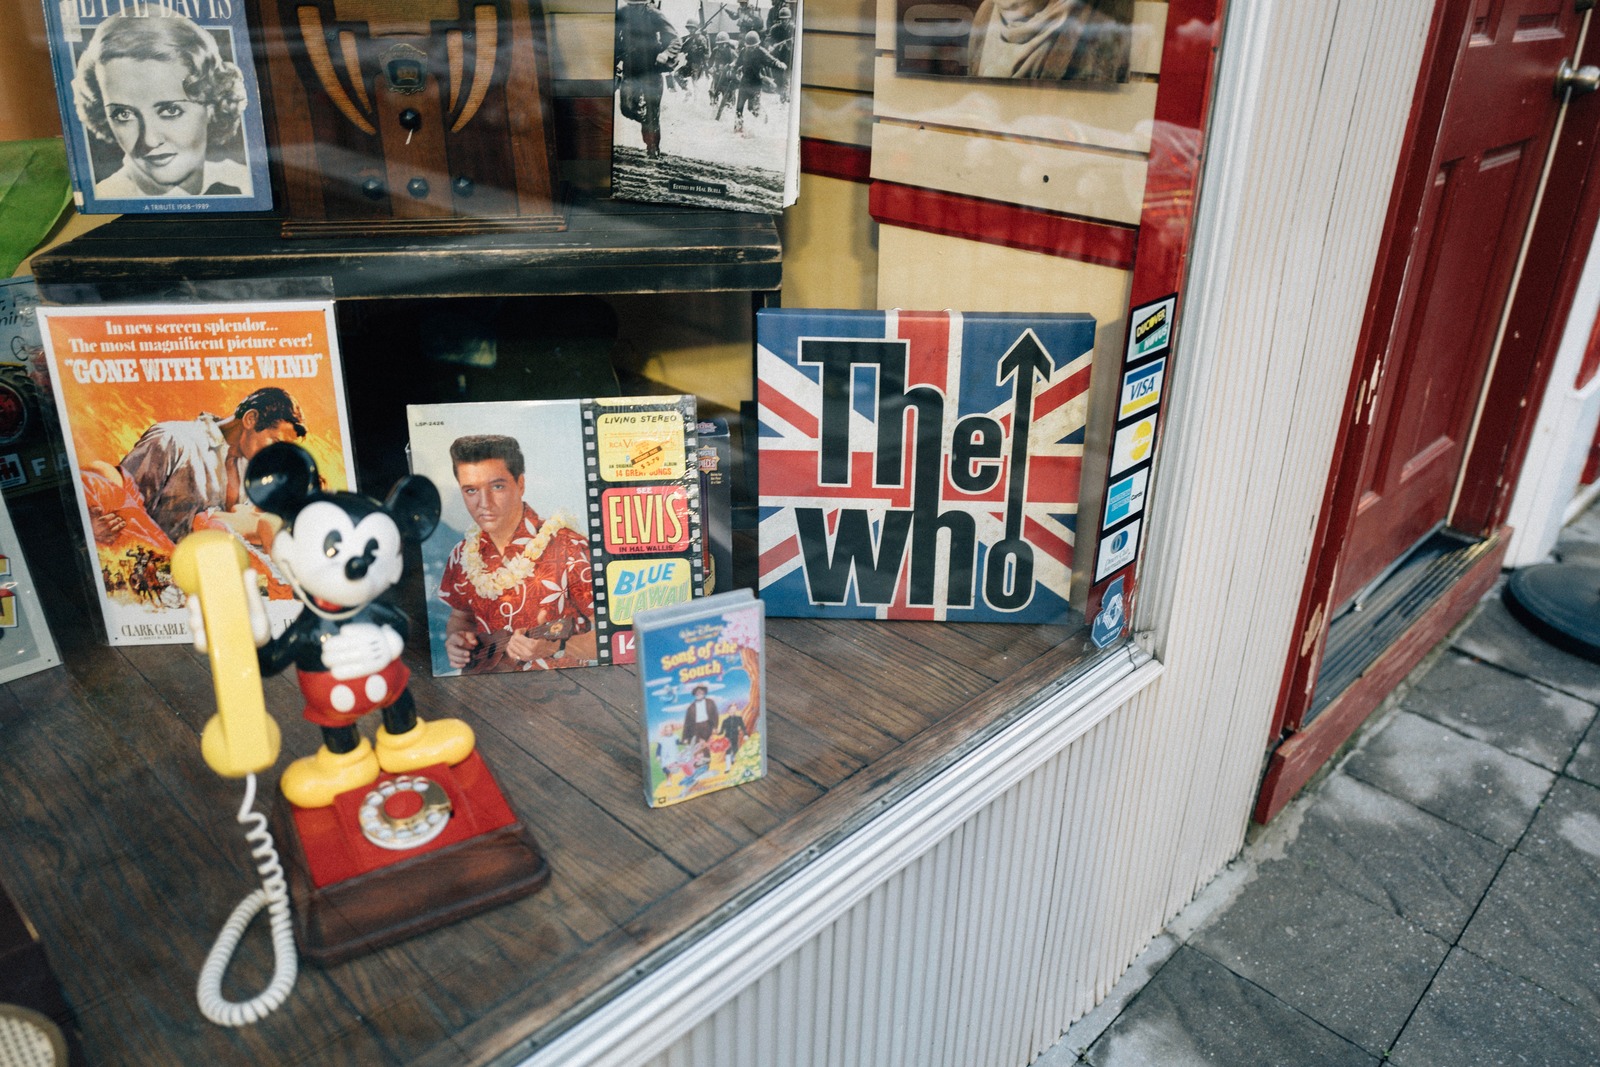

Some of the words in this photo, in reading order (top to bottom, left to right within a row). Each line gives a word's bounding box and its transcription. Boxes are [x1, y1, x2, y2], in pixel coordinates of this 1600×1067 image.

[105, 320, 123, 335] In
[124, 323, 153, 334] new
[155, 322, 202, 334] screen
[203, 317, 279, 336] splendor...
[68, 338, 98, 353] The
[100, 340, 136, 353] most
[138, 336, 224, 354] magnificent
[227, 335, 276, 353] picture
[278, 332, 313, 348] ever!
[64, 358, 140, 384] "GONE
[139, 357, 204, 382] WITH
[204, 356, 255, 381] THE
[255, 353, 323, 379] WIND"
[1130, 376, 1155, 401] VISA
[604, 416, 637, 424] LIVING
[640, 415, 677, 423] STEREO
[797, 336, 1005, 494] The
[615, 469, 623, 477] 14
[608, 493, 683, 545] ELVIS
[613, 562, 676, 597] BLUE
[121, 624, 154, 637] CLARK
[154, 622, 188, 635] GABLE
[661, 645, 697, 672] Song
[697, 641, 714, 660] of
[714, 640, 738, 656] the
[679, 659, 722, 684] South
